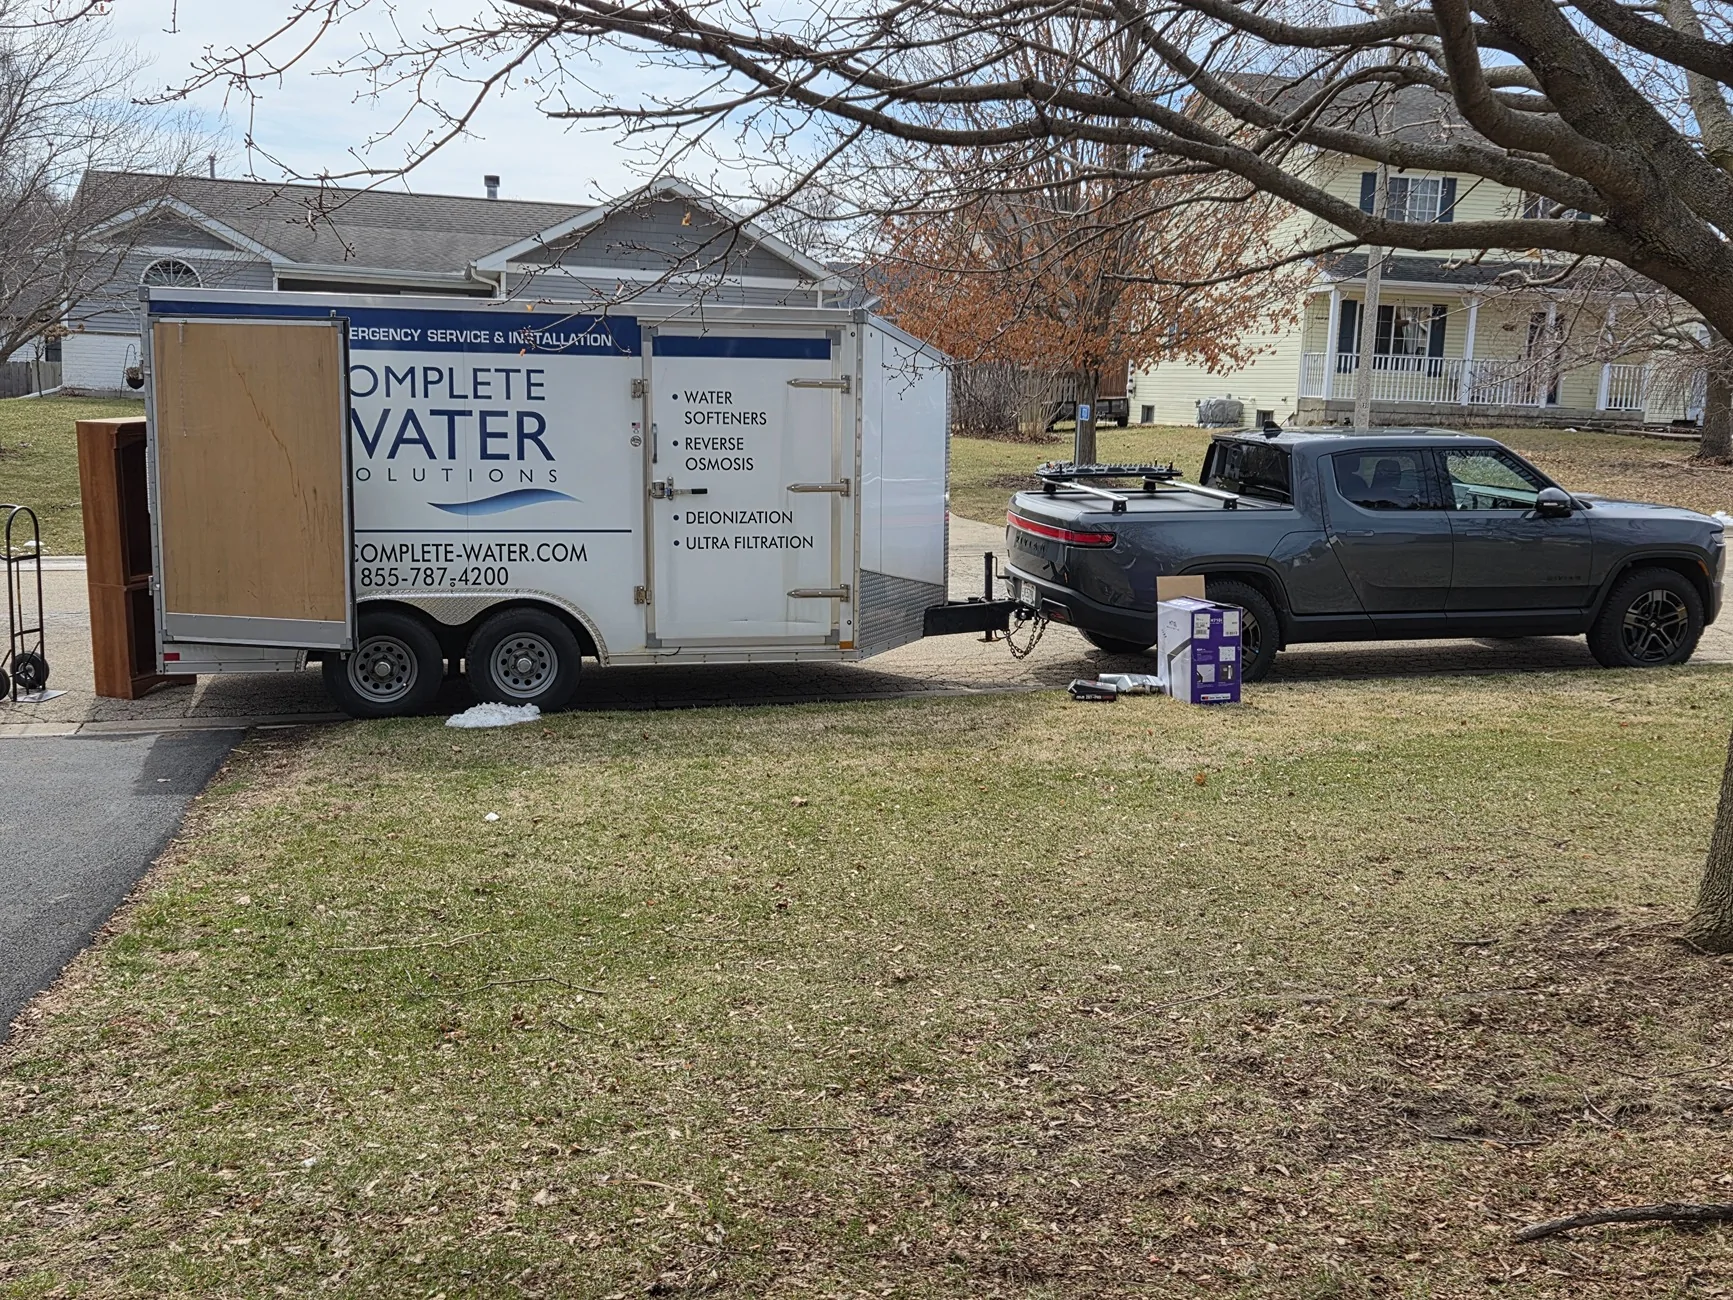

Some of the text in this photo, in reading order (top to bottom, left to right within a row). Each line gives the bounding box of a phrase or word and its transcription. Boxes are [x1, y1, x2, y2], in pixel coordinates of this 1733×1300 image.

[350, 327, 612, 347] ERGENCY SERVICE & INSTALLATION
[350, 365, 546, 401] OMPLETE
[684, 390, 733, 405] WATER
[684, 411, 767, 426] SOFTENERS
[685, 437, 744, 451] REVERSE
[685, 457, 754, 471] OSMOSIS
[356, 467, 558, 483] OLUTIONS
[686, 511, 793, 525] DEIONIZATION
[686, 536, 814, 550] ULTRA FILTRATION
[360, 566, 509, 587] 855-787-4200
